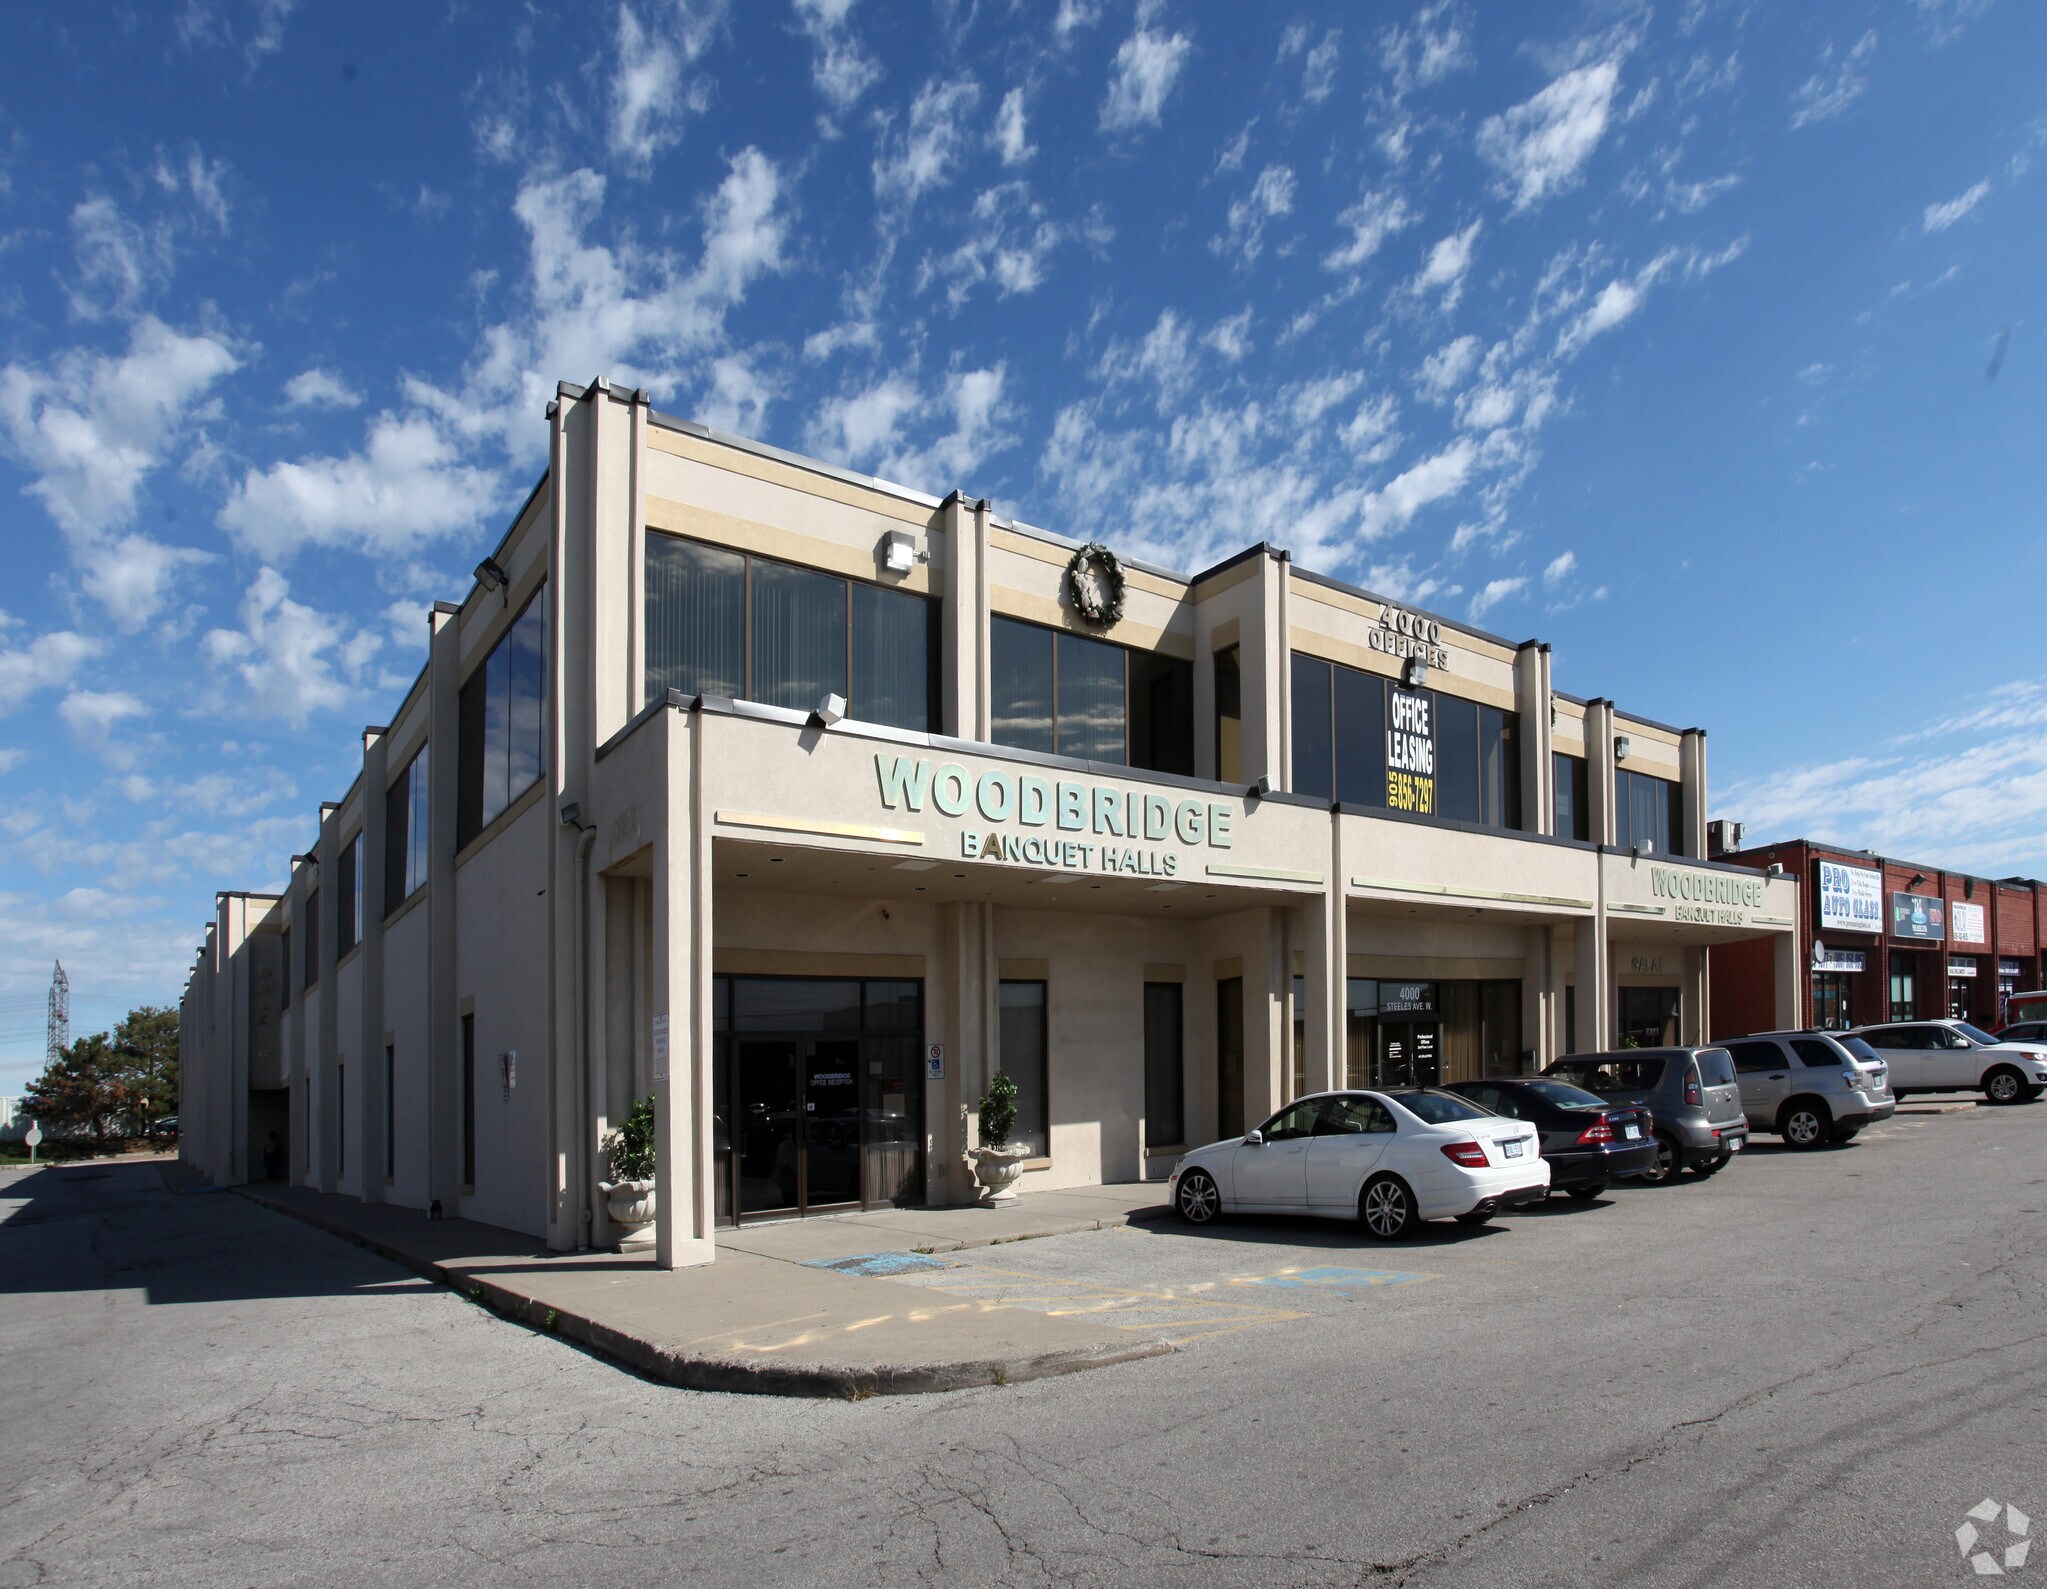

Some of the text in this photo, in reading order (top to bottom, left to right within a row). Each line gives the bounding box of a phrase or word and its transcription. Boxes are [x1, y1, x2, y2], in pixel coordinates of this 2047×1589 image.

[1379, 605, 1441, 647] 4000
[1369, 627, 1449, 672] OFFICES
[1392, 692, 1429, 736] OFFICE
[1388, 730, 1433, 775] LEASING
[874, 753, 1234, 849] WOODBRIDGE
[1388, 771, 1398, 807] 905
[1397, 773, 1433, 814] 856-7297
[961, 830, 1179, 877] BANQUET HALLS
[1651, 866, 1761, 908] WOODBRIDGE
[1822, 865, 1850, 895] PRO
[1675, 904, 1744, 926] BANQUET HALLS
[1823, 895, 1851, 917] AUTO
[1853, 898, 1879, 921] GLASS
[1386, 1002, 1412, 1011] STEELES
[1399, 987, 1420, 1000] 4000
[810, 1078, 854, 1087] OFFICE RECEPTION
[813, 1072, 851, 1080] WOODBRIDGE
